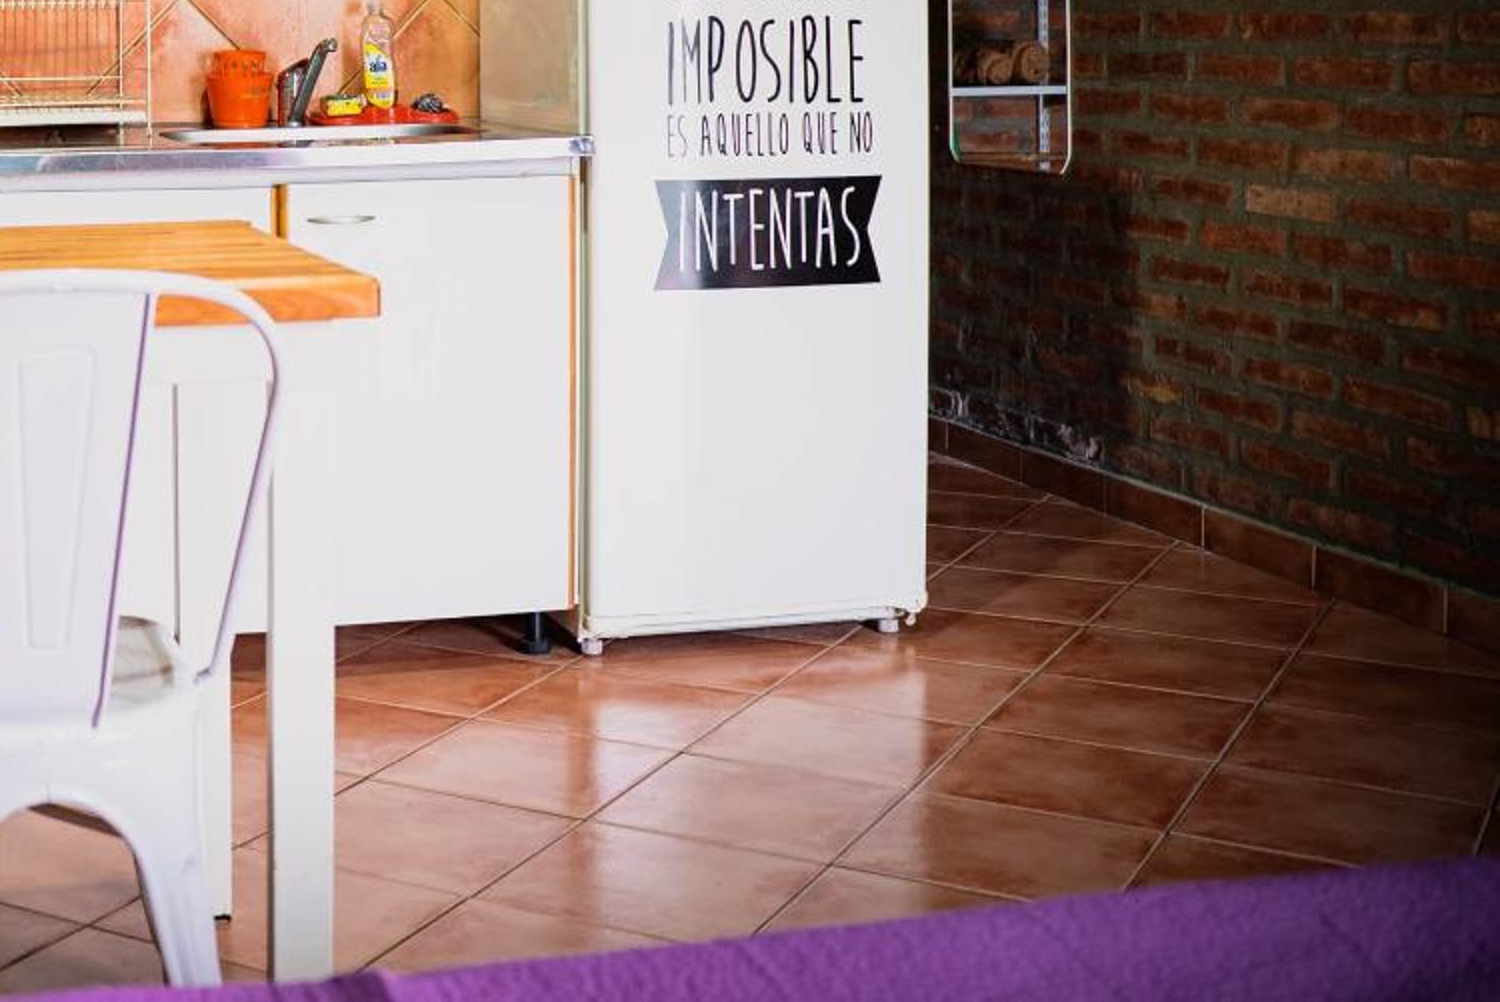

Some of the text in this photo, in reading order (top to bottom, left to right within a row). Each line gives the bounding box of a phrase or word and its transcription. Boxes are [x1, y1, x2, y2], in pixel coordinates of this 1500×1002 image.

[667, 15, 864, 105] IMPOSIBLE
[667, 111, 874, 159] ES AQUELLO QUE NO
[677, 185, 862, 273] INTENTAS
